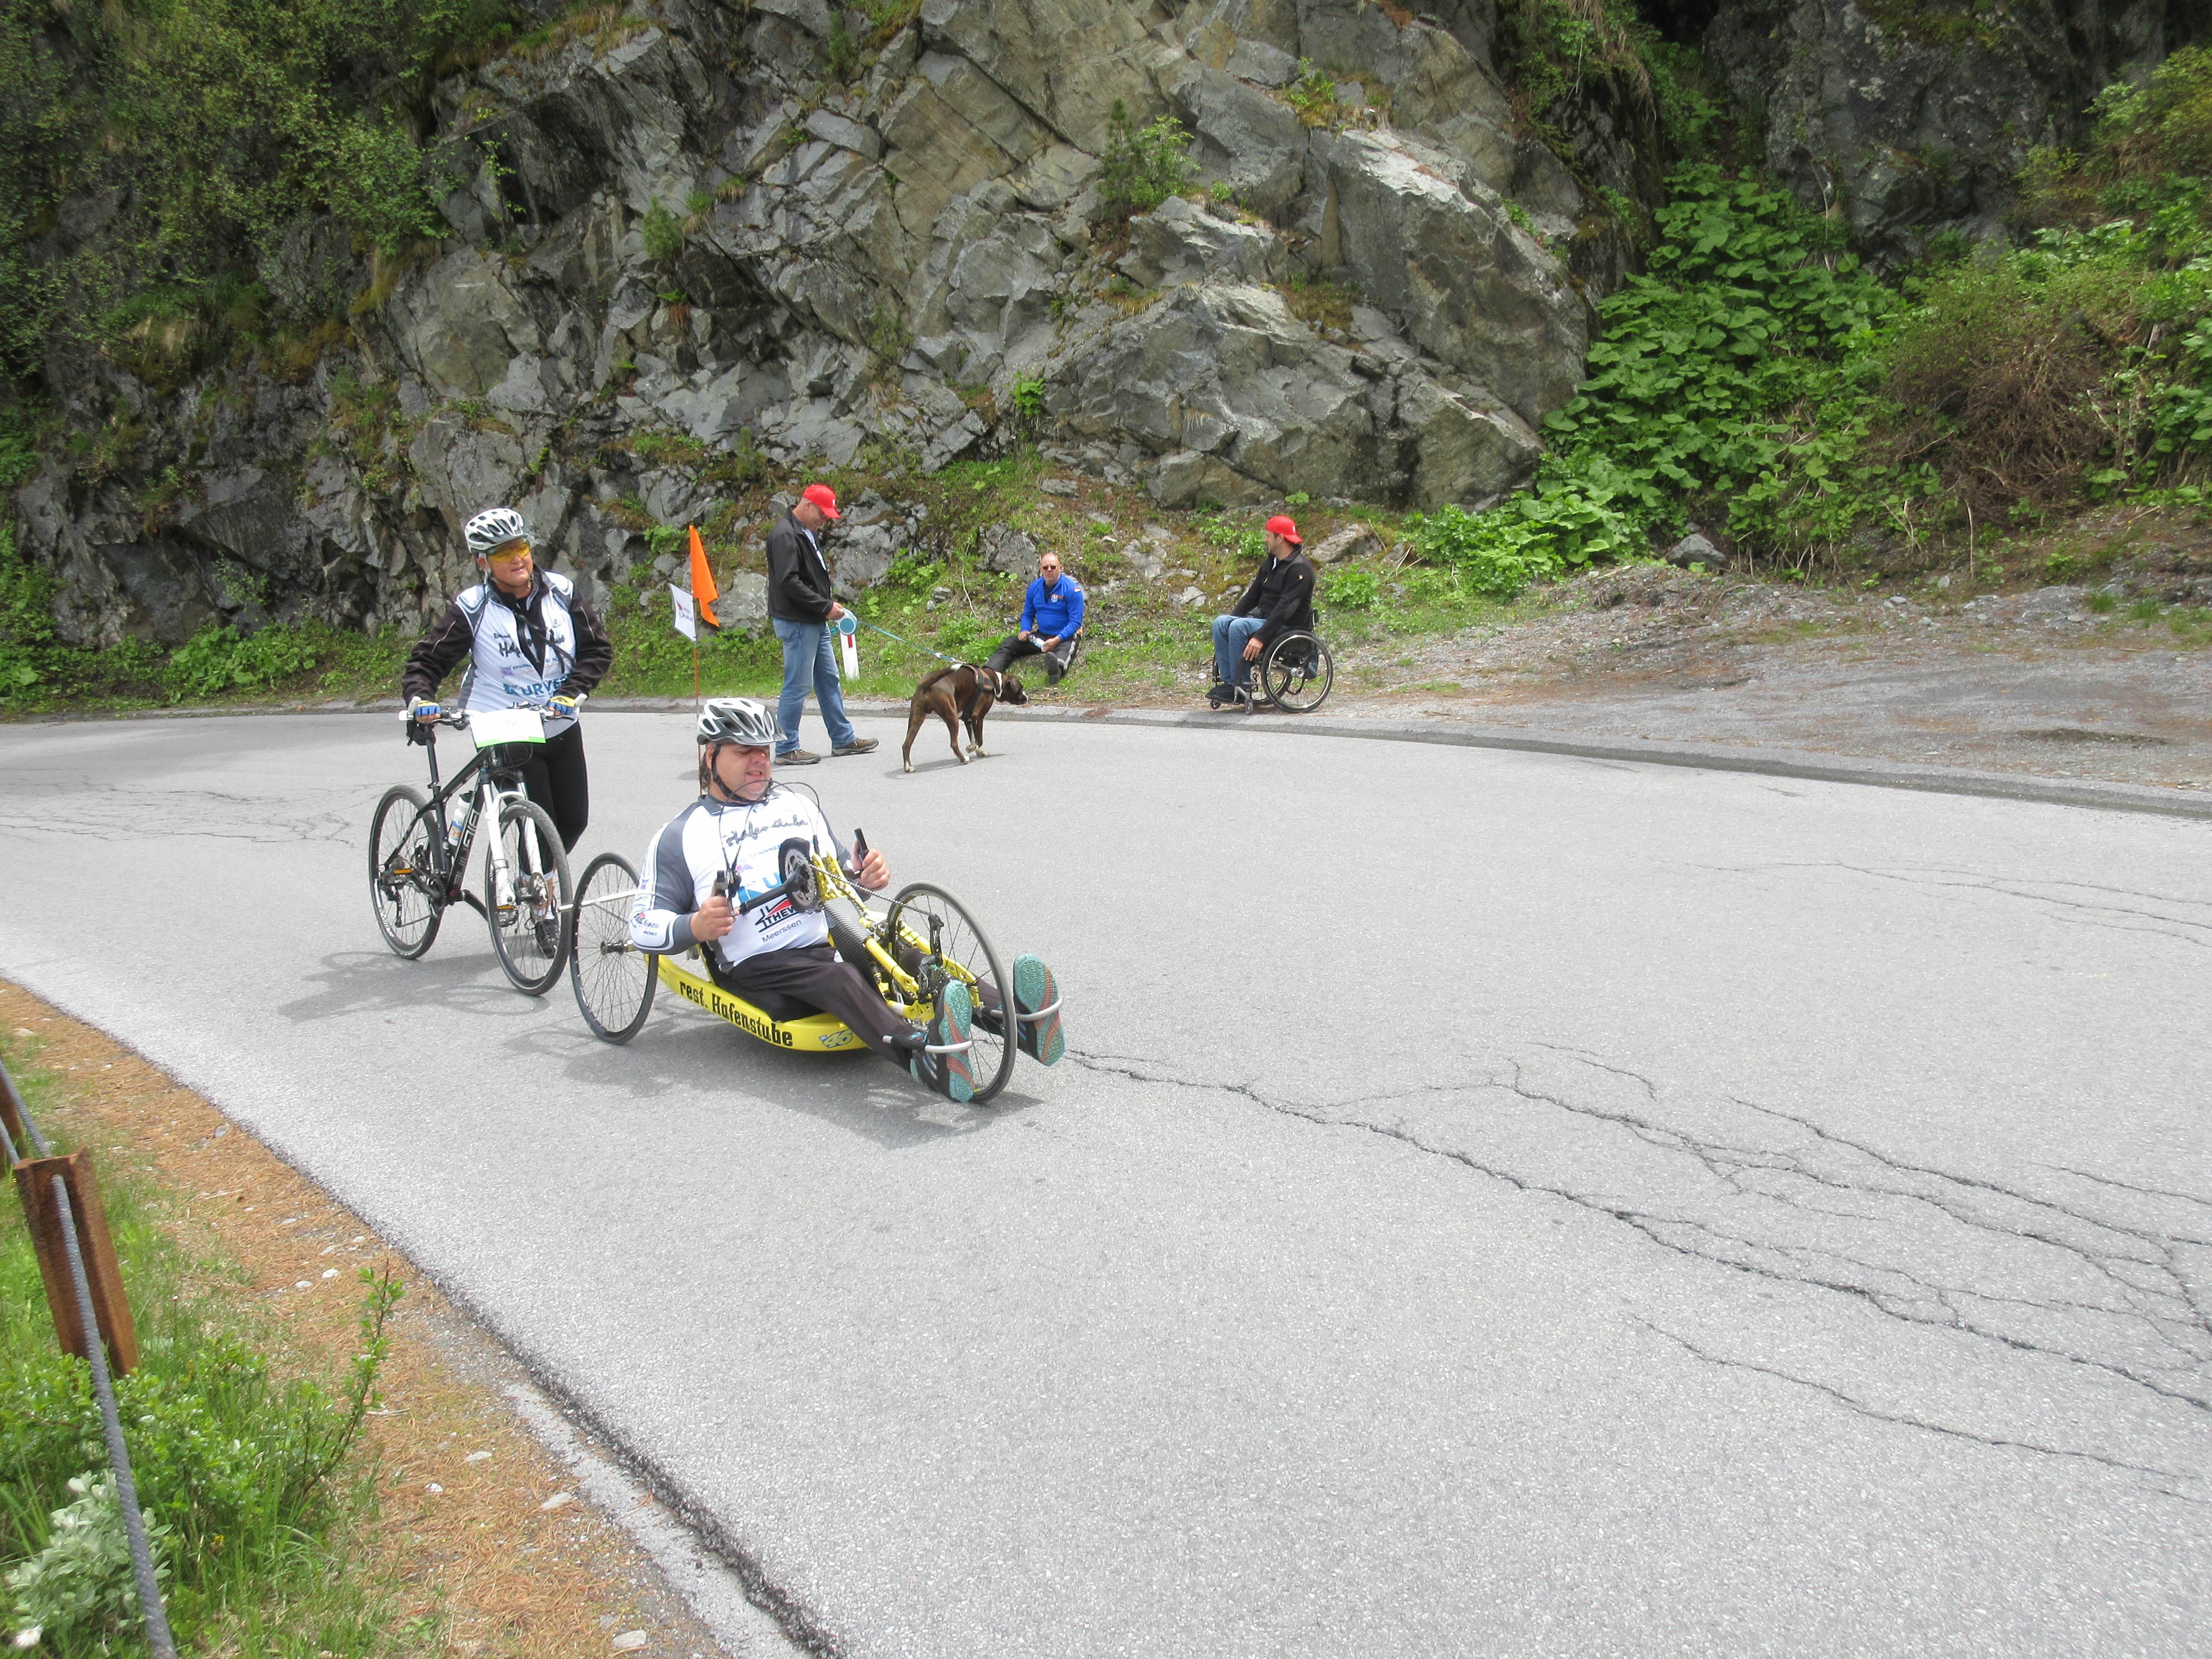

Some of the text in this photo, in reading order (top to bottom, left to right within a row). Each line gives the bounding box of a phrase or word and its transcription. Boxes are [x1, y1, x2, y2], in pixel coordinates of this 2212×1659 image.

[762, 920, 802, 943] Meerssen
[679, 981, 793, 1047] rest. Hafenstube
